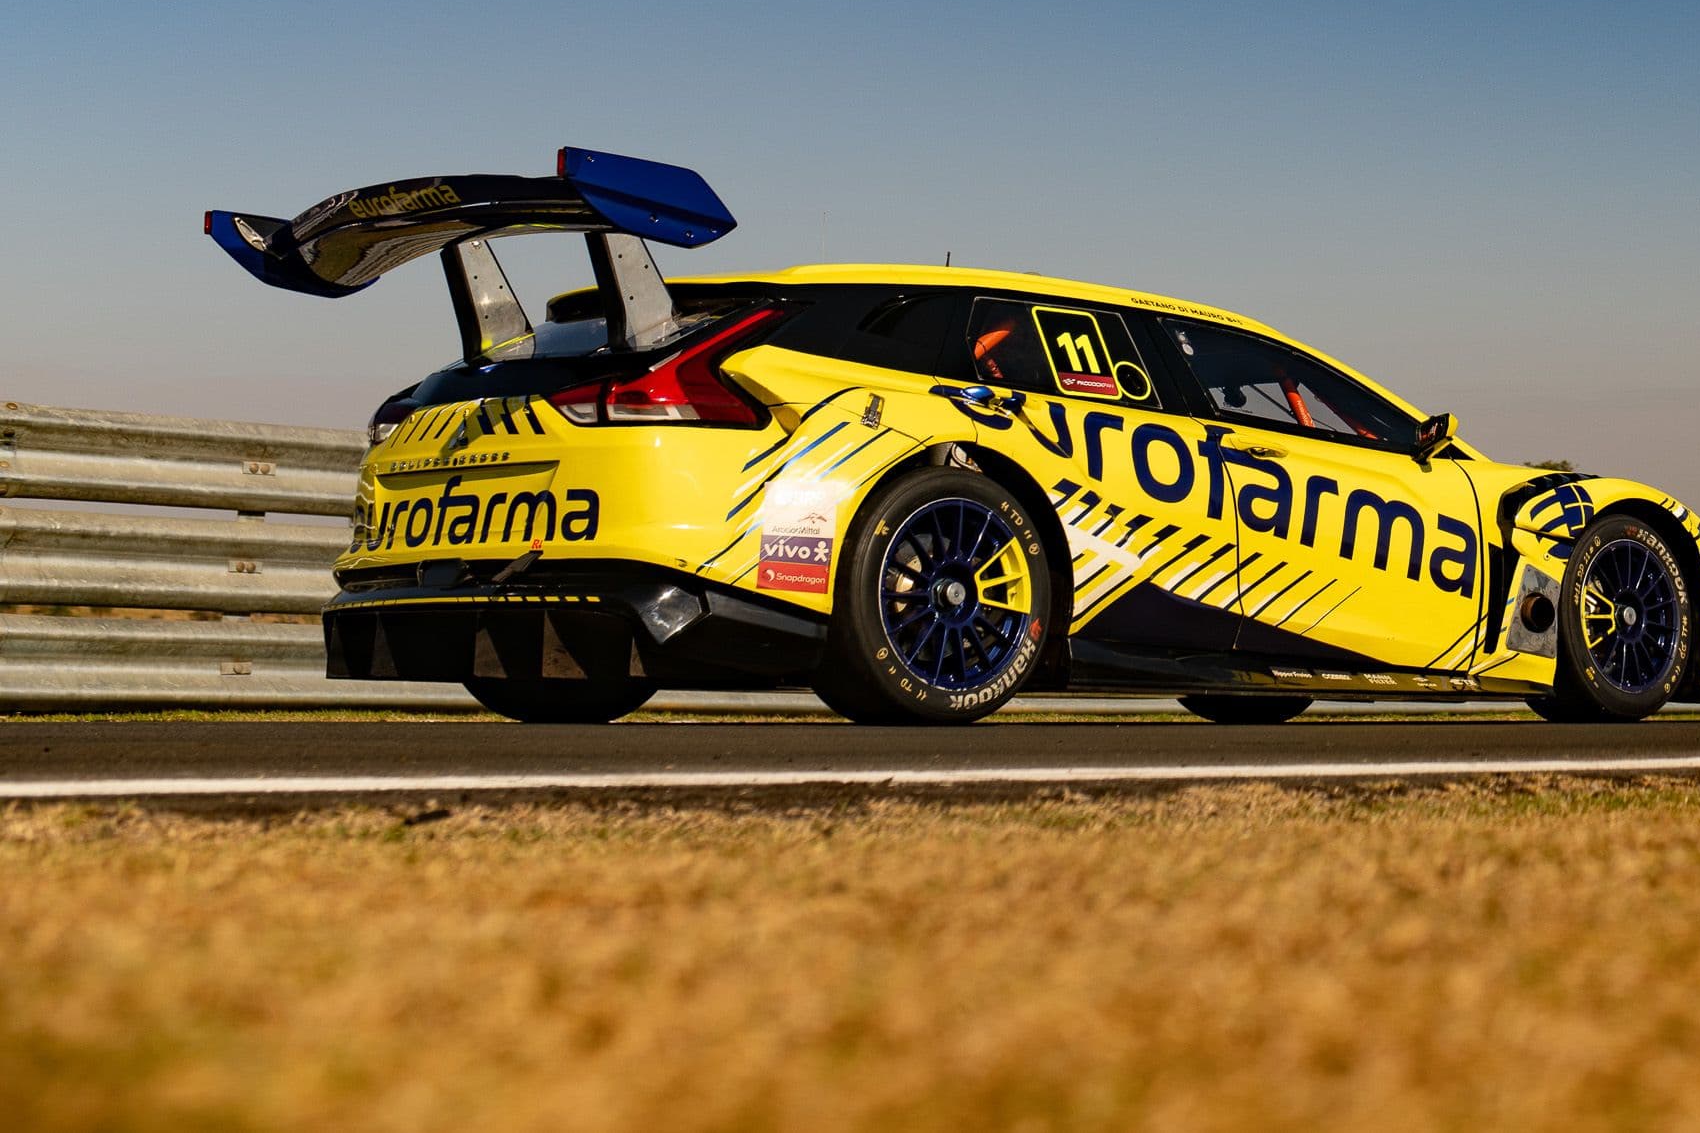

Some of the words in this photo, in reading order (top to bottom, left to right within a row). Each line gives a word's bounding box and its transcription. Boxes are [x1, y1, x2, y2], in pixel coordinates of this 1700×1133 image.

[350, 185, 461, 217] eurofarma
[1130, 298, 1176, 311] GAETANO
[1190, 308, 1224, 321] MAURO
[1056, 332, 1101, 374] 11
[764, 539, 811, 559] vivo
[776, 572, 826, 585] Snapdragon
